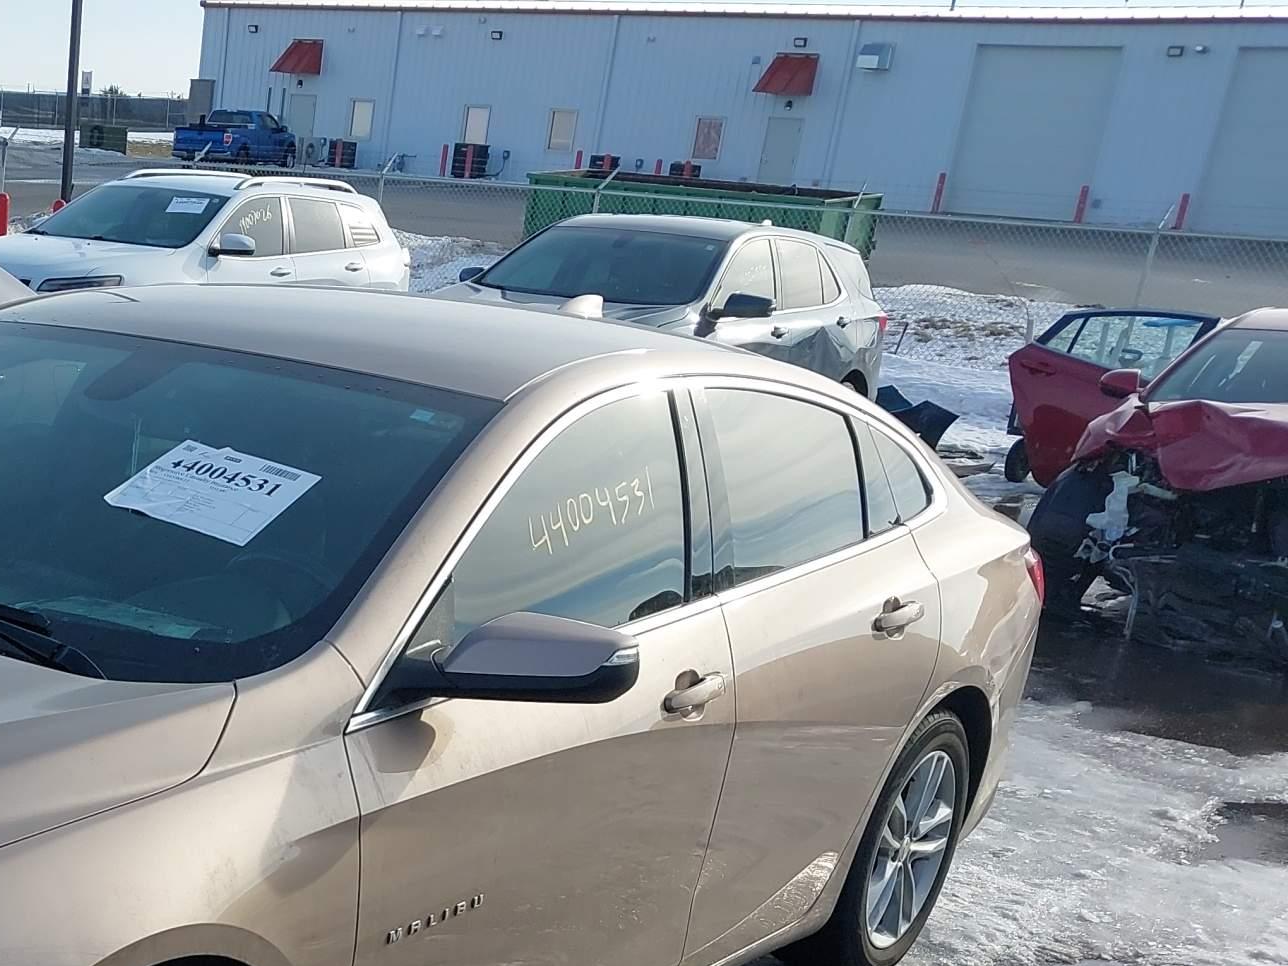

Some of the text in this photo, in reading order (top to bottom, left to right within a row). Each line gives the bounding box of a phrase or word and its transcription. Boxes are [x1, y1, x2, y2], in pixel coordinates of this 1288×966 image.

[170, 458, 284, 498] 44004531
[528, 465, 655, 555] 44004531
[386, 893, 484, 945] MALIBU
